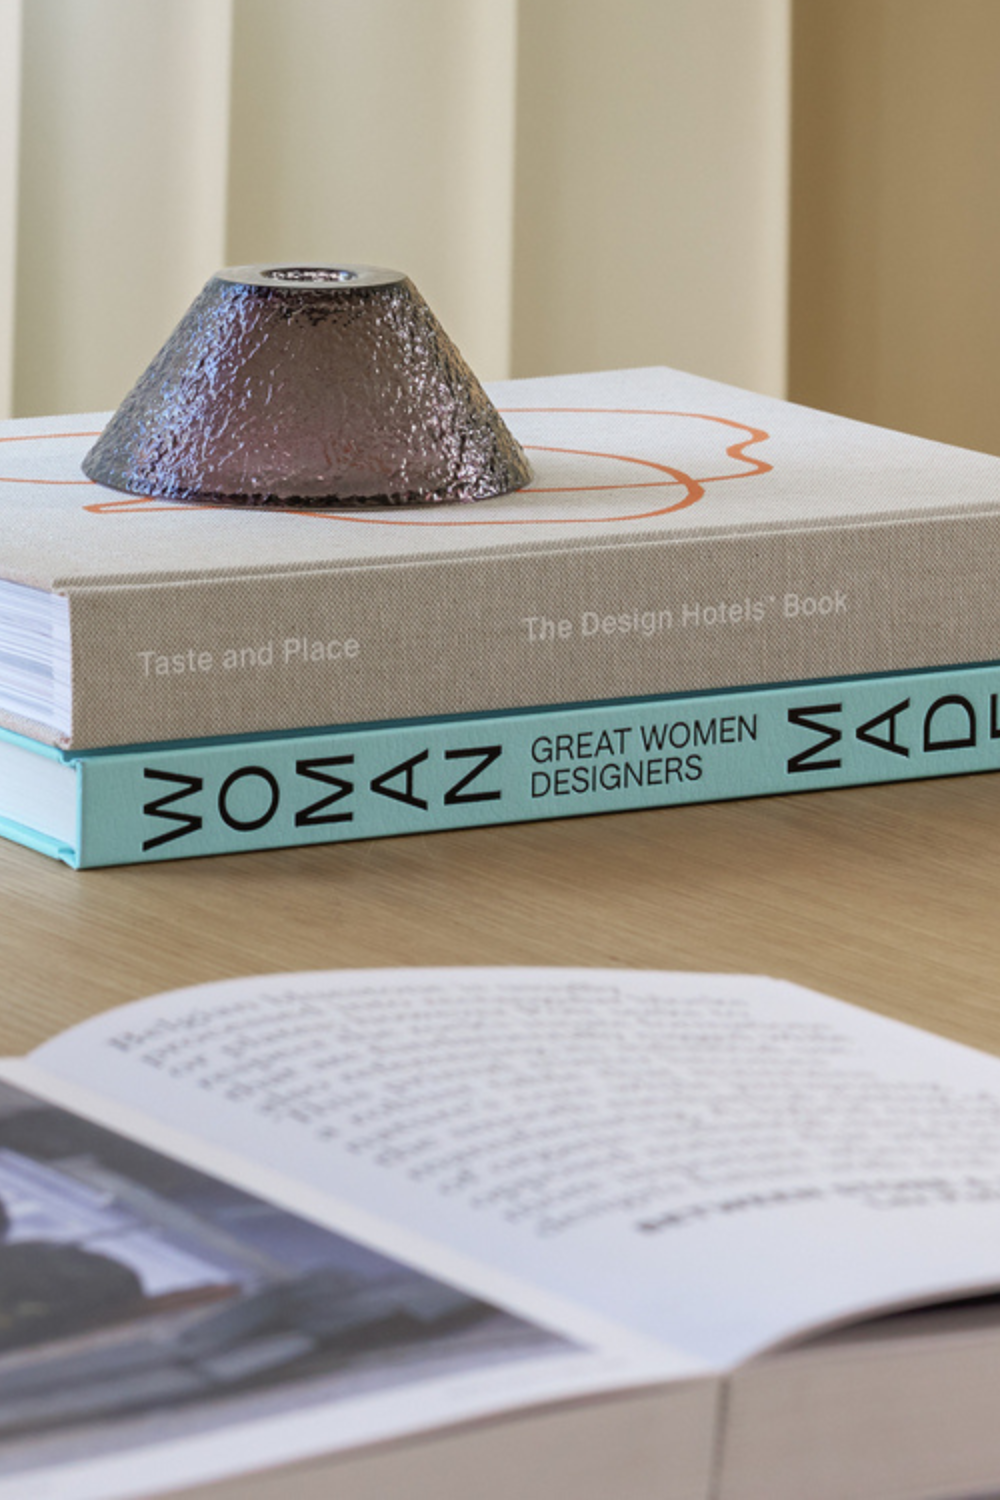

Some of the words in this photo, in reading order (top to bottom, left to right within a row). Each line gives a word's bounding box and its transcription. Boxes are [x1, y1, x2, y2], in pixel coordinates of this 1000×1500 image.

[523, 616, 572, 643] The
[581, 608, 673, 637] Design
[784, 590, 848, 618] Book
[138, 647, 213, 677] Taste
[222, 641, 273, 670] and
[284, 636, 361, 665] Place
[530, 728, 632, 763] GREAT
[640, 714, 758, 752] WOMEN
[787, 693, 1000, 774] MAD
[142, 744, 503, 852] WOMAN
[530, 754, 704, 798] DESIGNERS
